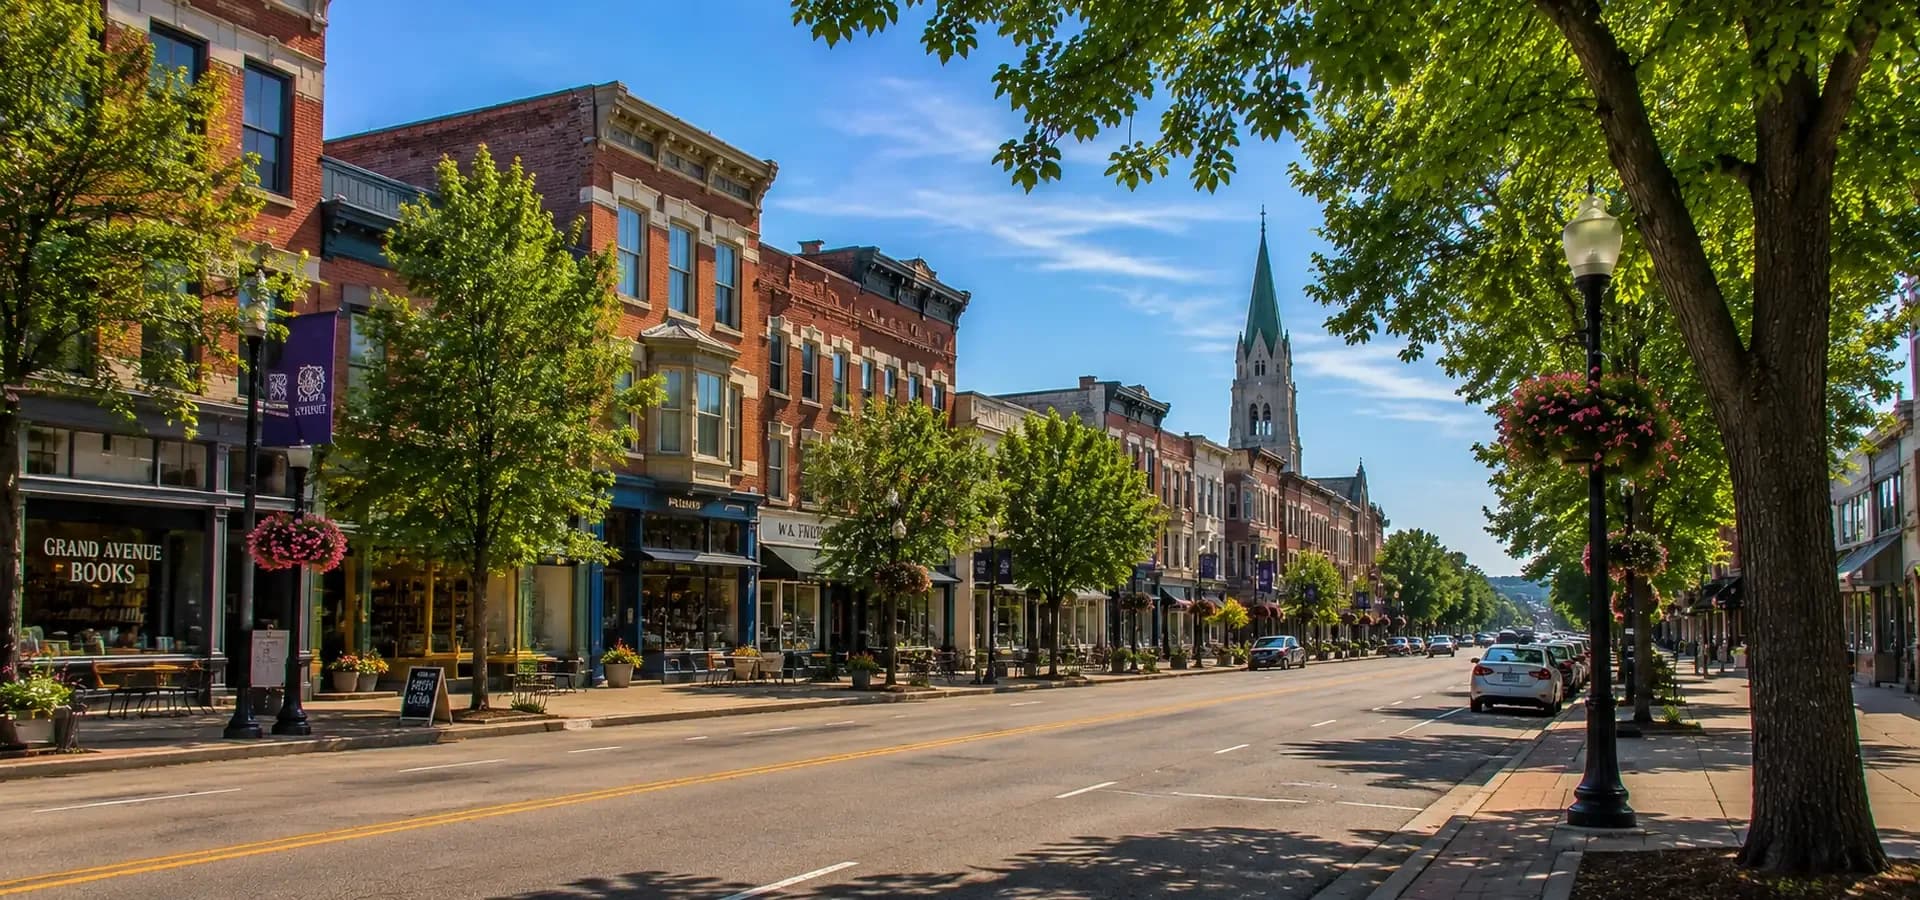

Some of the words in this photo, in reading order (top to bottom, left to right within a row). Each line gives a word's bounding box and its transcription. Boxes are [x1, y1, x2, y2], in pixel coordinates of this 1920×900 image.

[44, 537, 99, 557] GRAND
[103, 541, 162, 561] AVENUE
[70, 561, 135, 584] BOOKS
